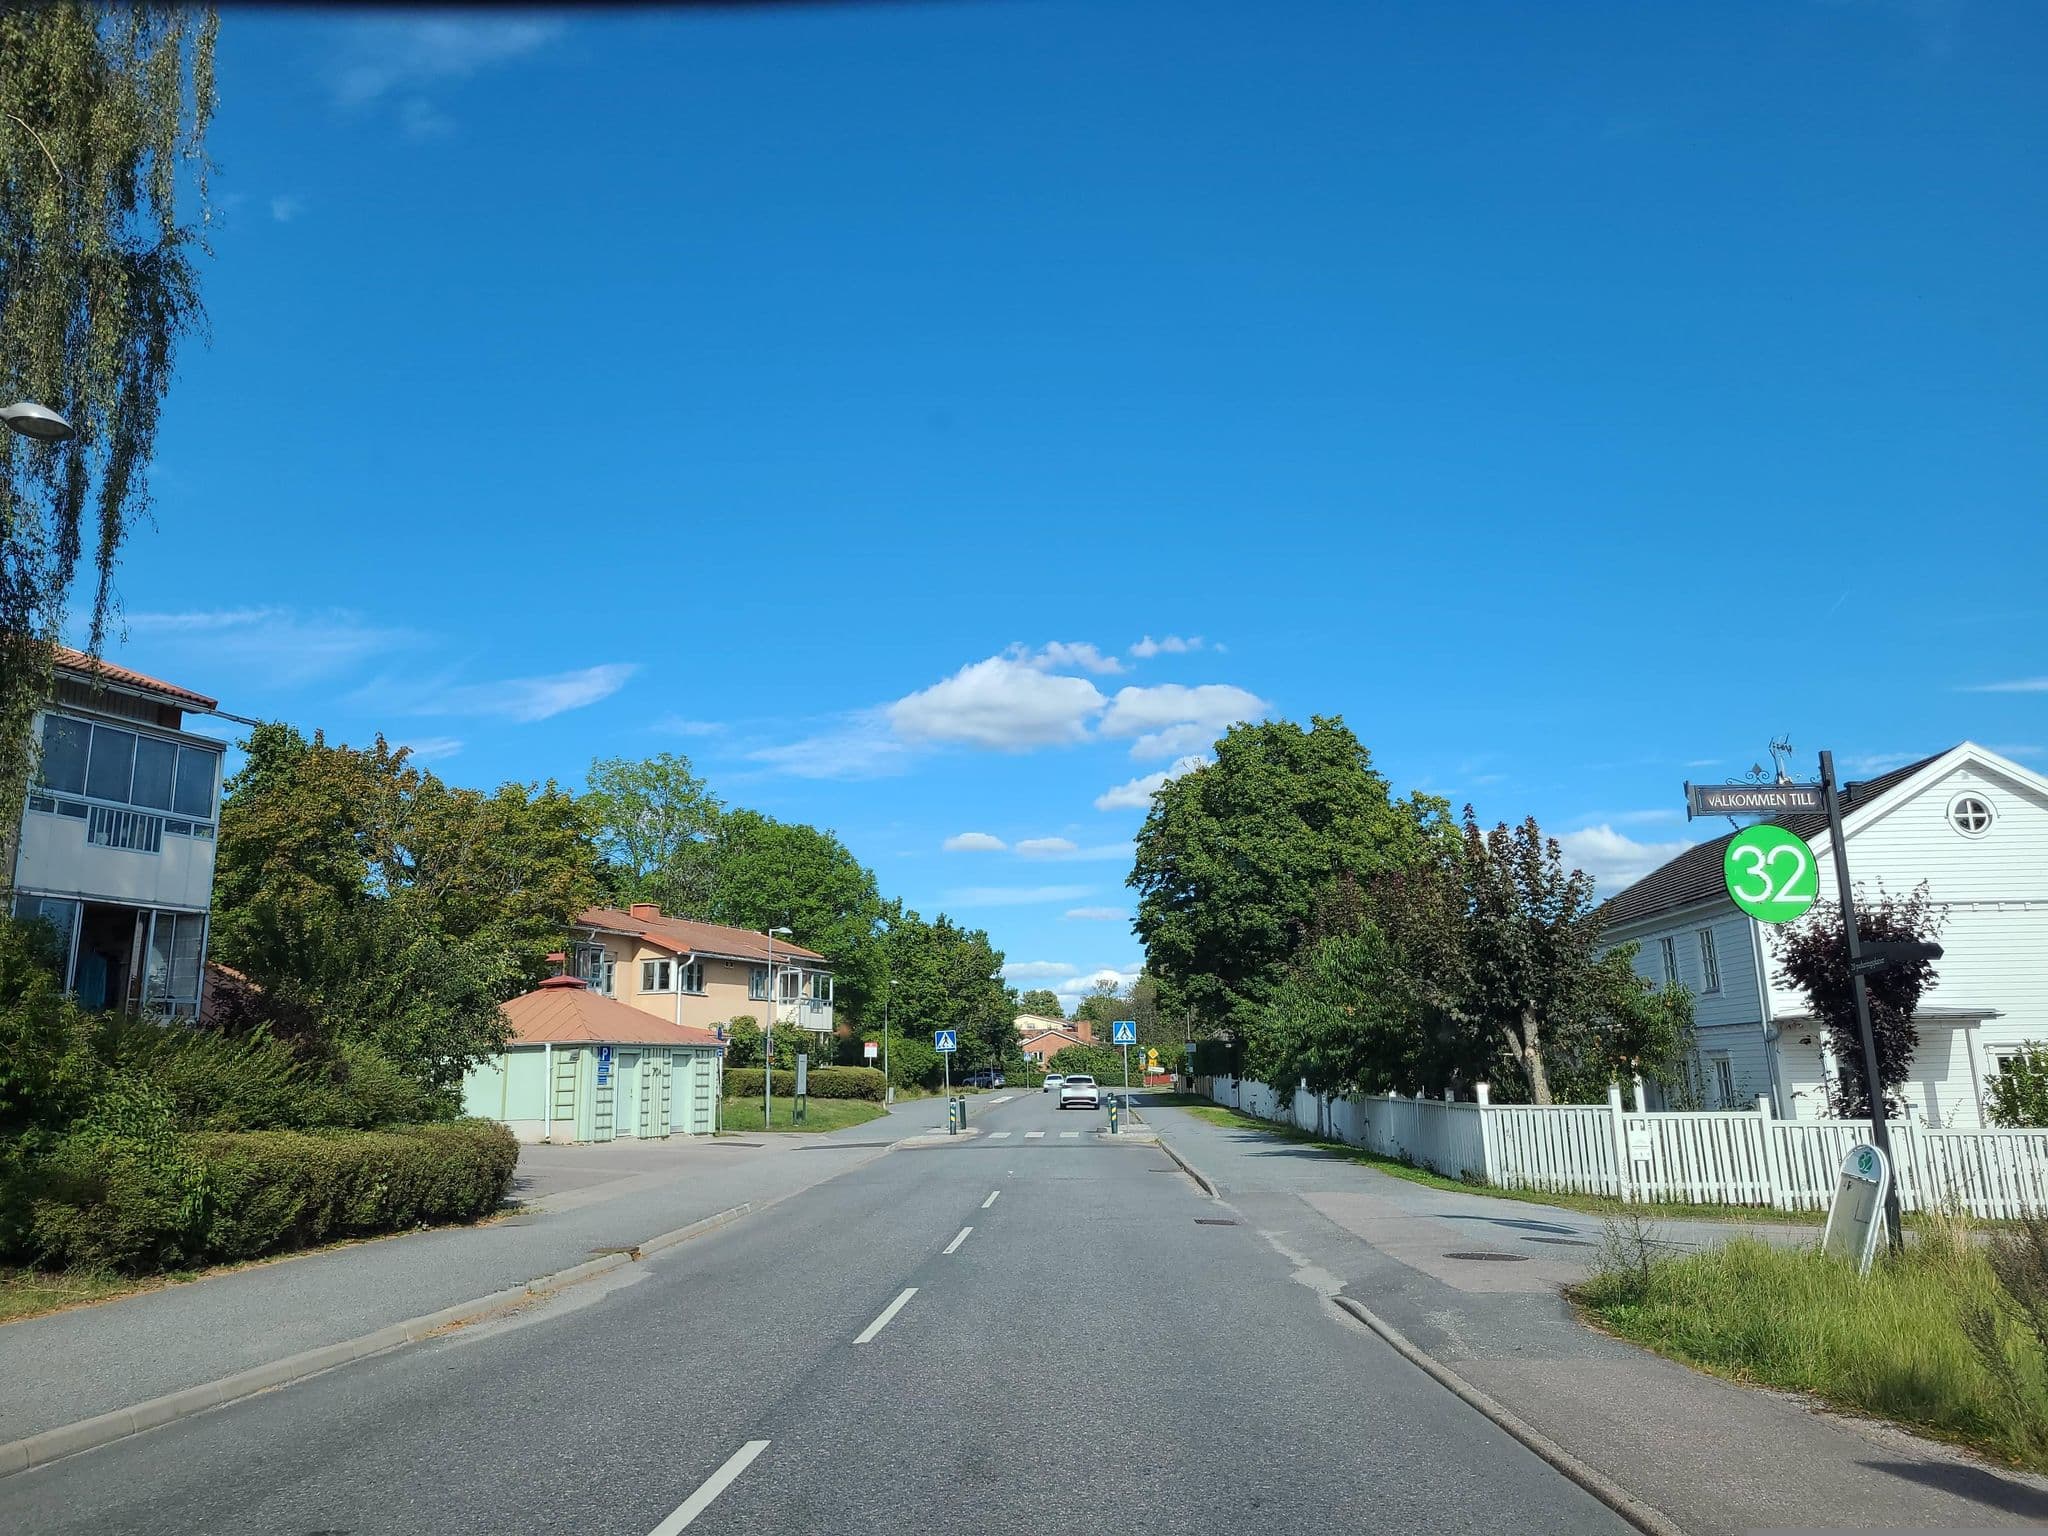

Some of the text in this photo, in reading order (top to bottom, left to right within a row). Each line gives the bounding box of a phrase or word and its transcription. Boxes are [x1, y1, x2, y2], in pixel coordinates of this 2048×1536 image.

[1789, 793, 1815, 805] TILL
[1732, 845, 1811, 903] 32
[602, 1047, 609, 1060] P
